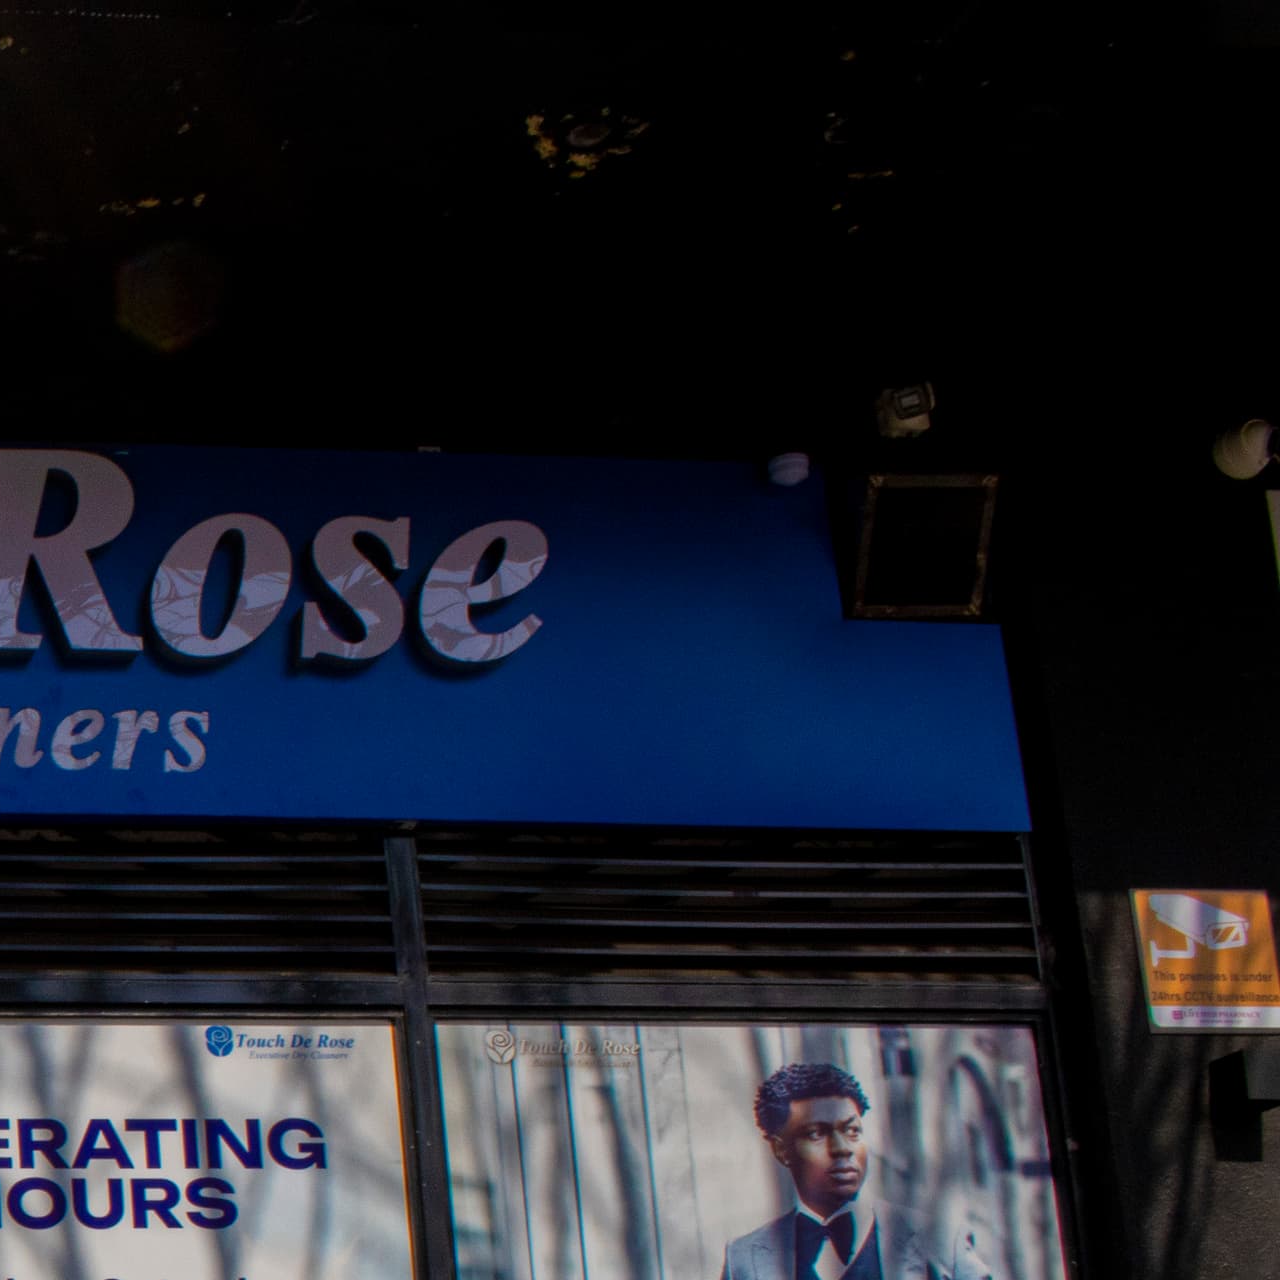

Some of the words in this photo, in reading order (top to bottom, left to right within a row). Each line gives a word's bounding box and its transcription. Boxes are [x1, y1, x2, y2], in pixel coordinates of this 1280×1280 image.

[1152, 970, 1176, 981] This
[236, 1033, 285, 1049] Touch
[290, 1033, 312, 1049] De
[317, 1034, 355, 1049] Rose
[519, 1039, 568, 1055] Touch
[601, 1039, 641, 1056] Rose
